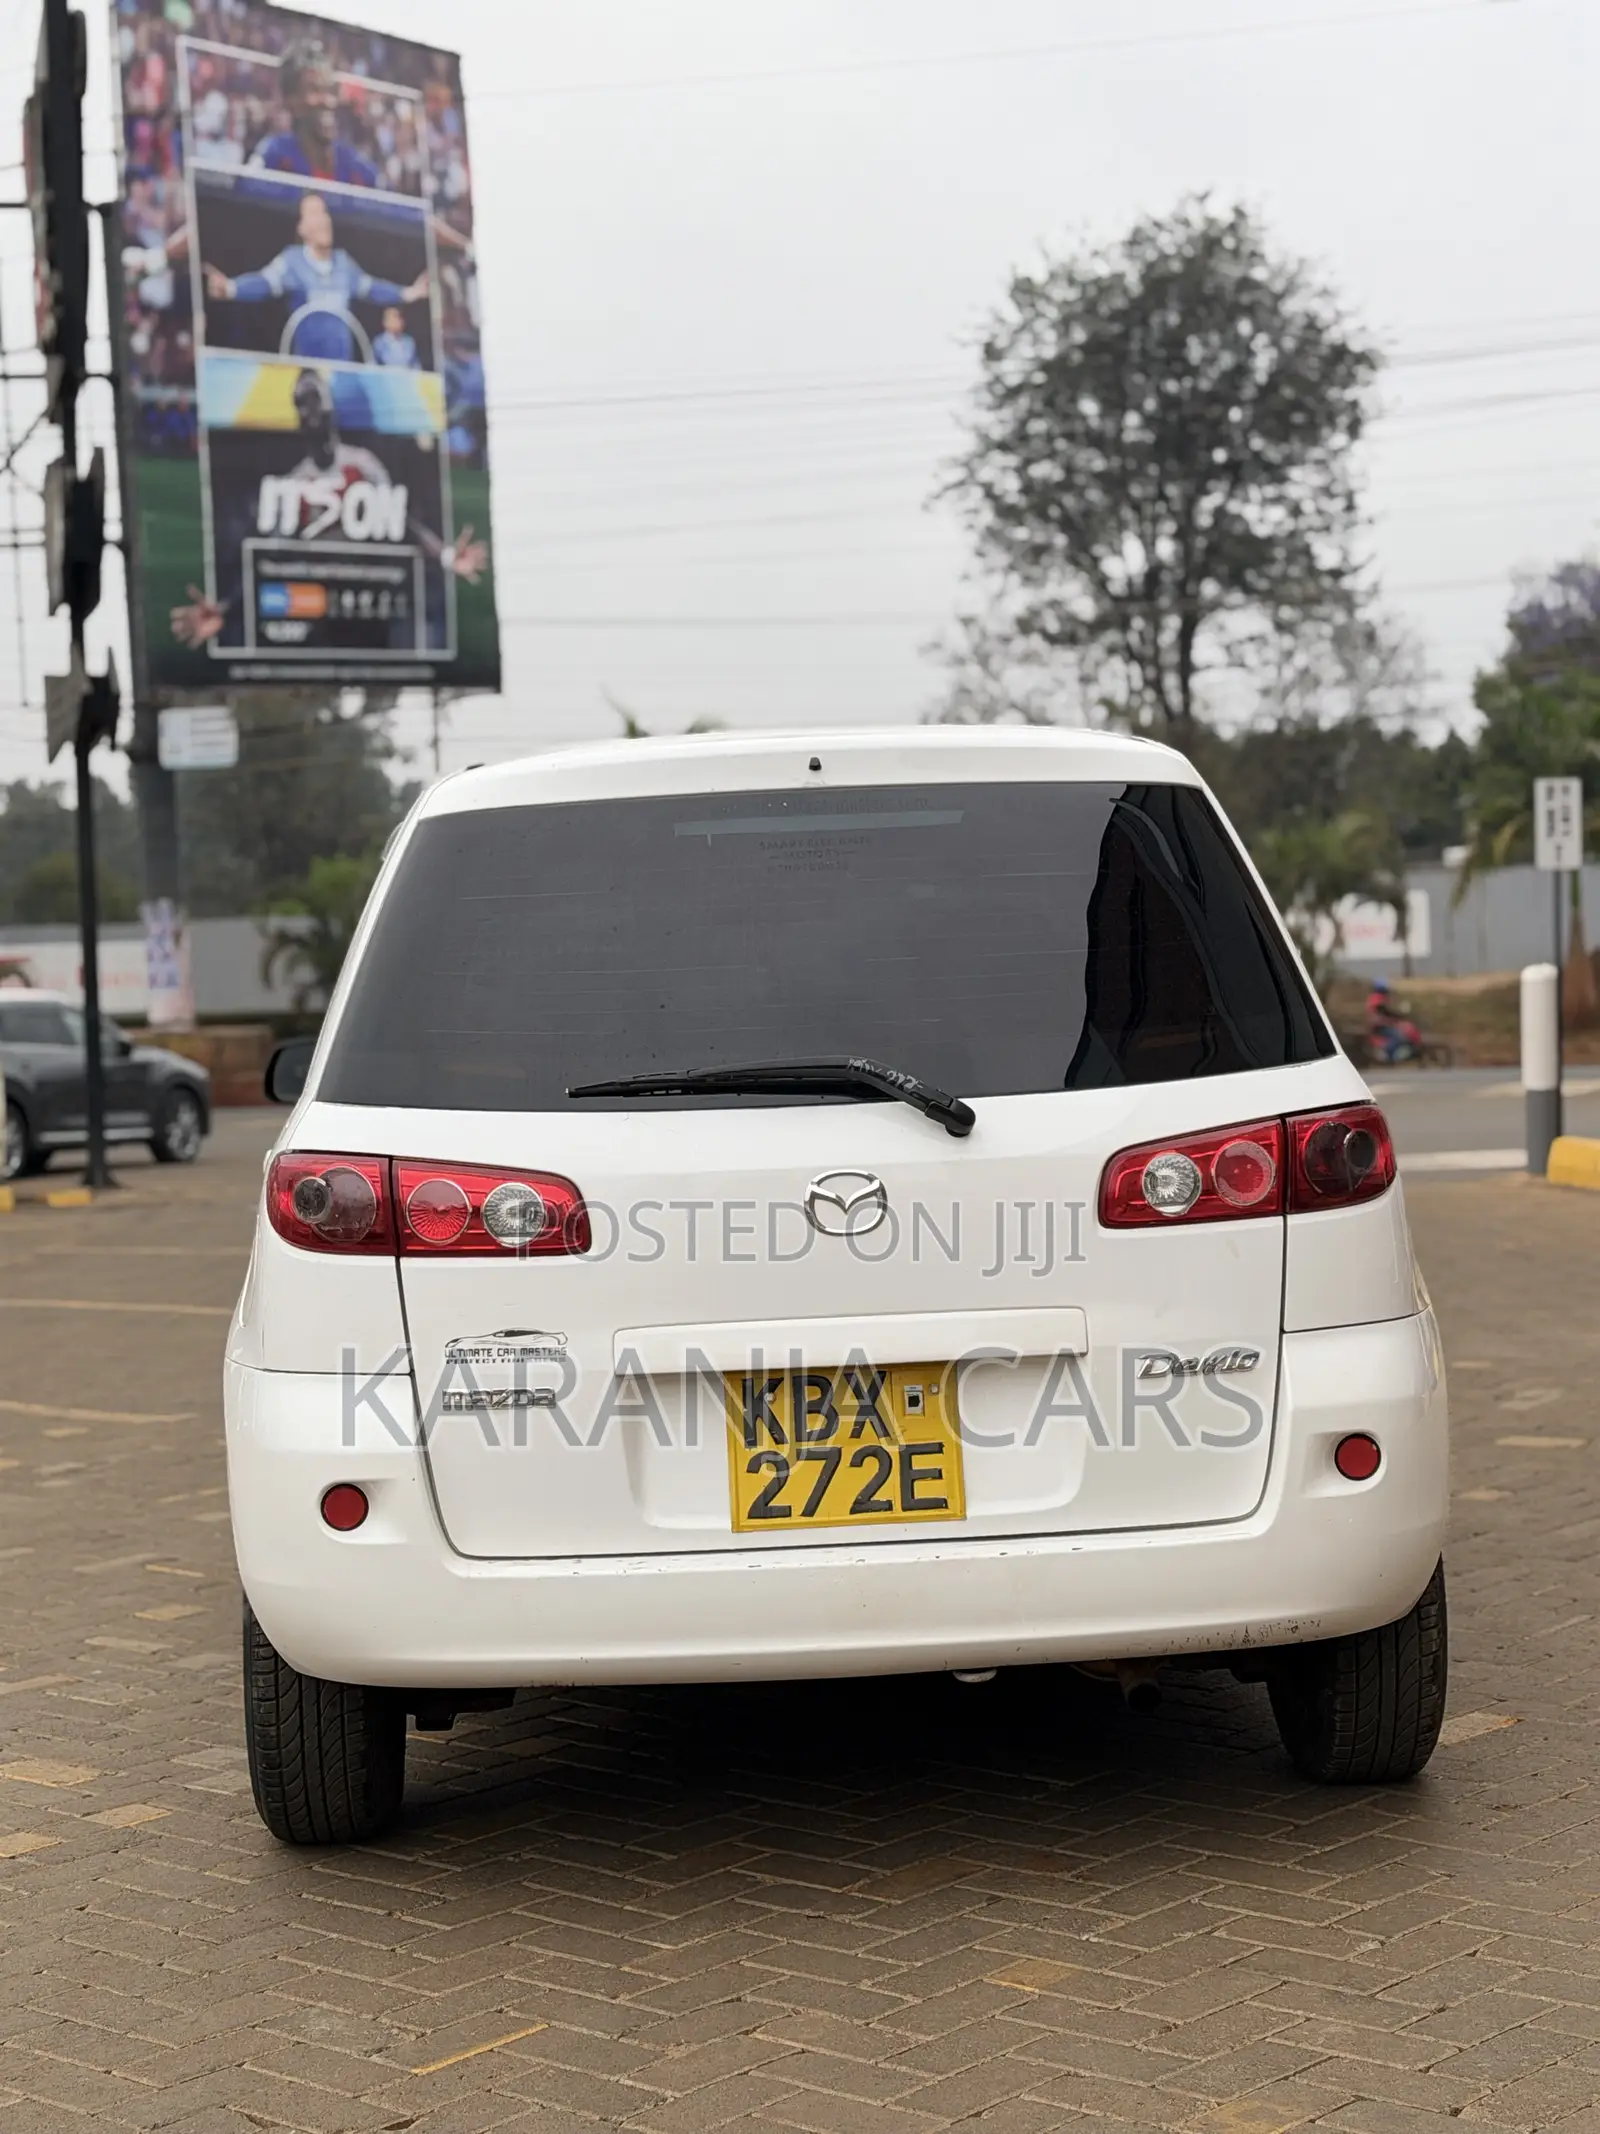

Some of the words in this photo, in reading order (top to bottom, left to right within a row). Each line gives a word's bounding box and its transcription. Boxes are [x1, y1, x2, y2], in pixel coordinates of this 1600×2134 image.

[444, 1347, 493, 1358] ULTIMATE
[497, 1347, 516, 1357] CAR
[519, 1347, 567, 1357] MASTERS
[742, 1370, 892, 1449] KBX
[746, 1441, 949, 1519] 272E
